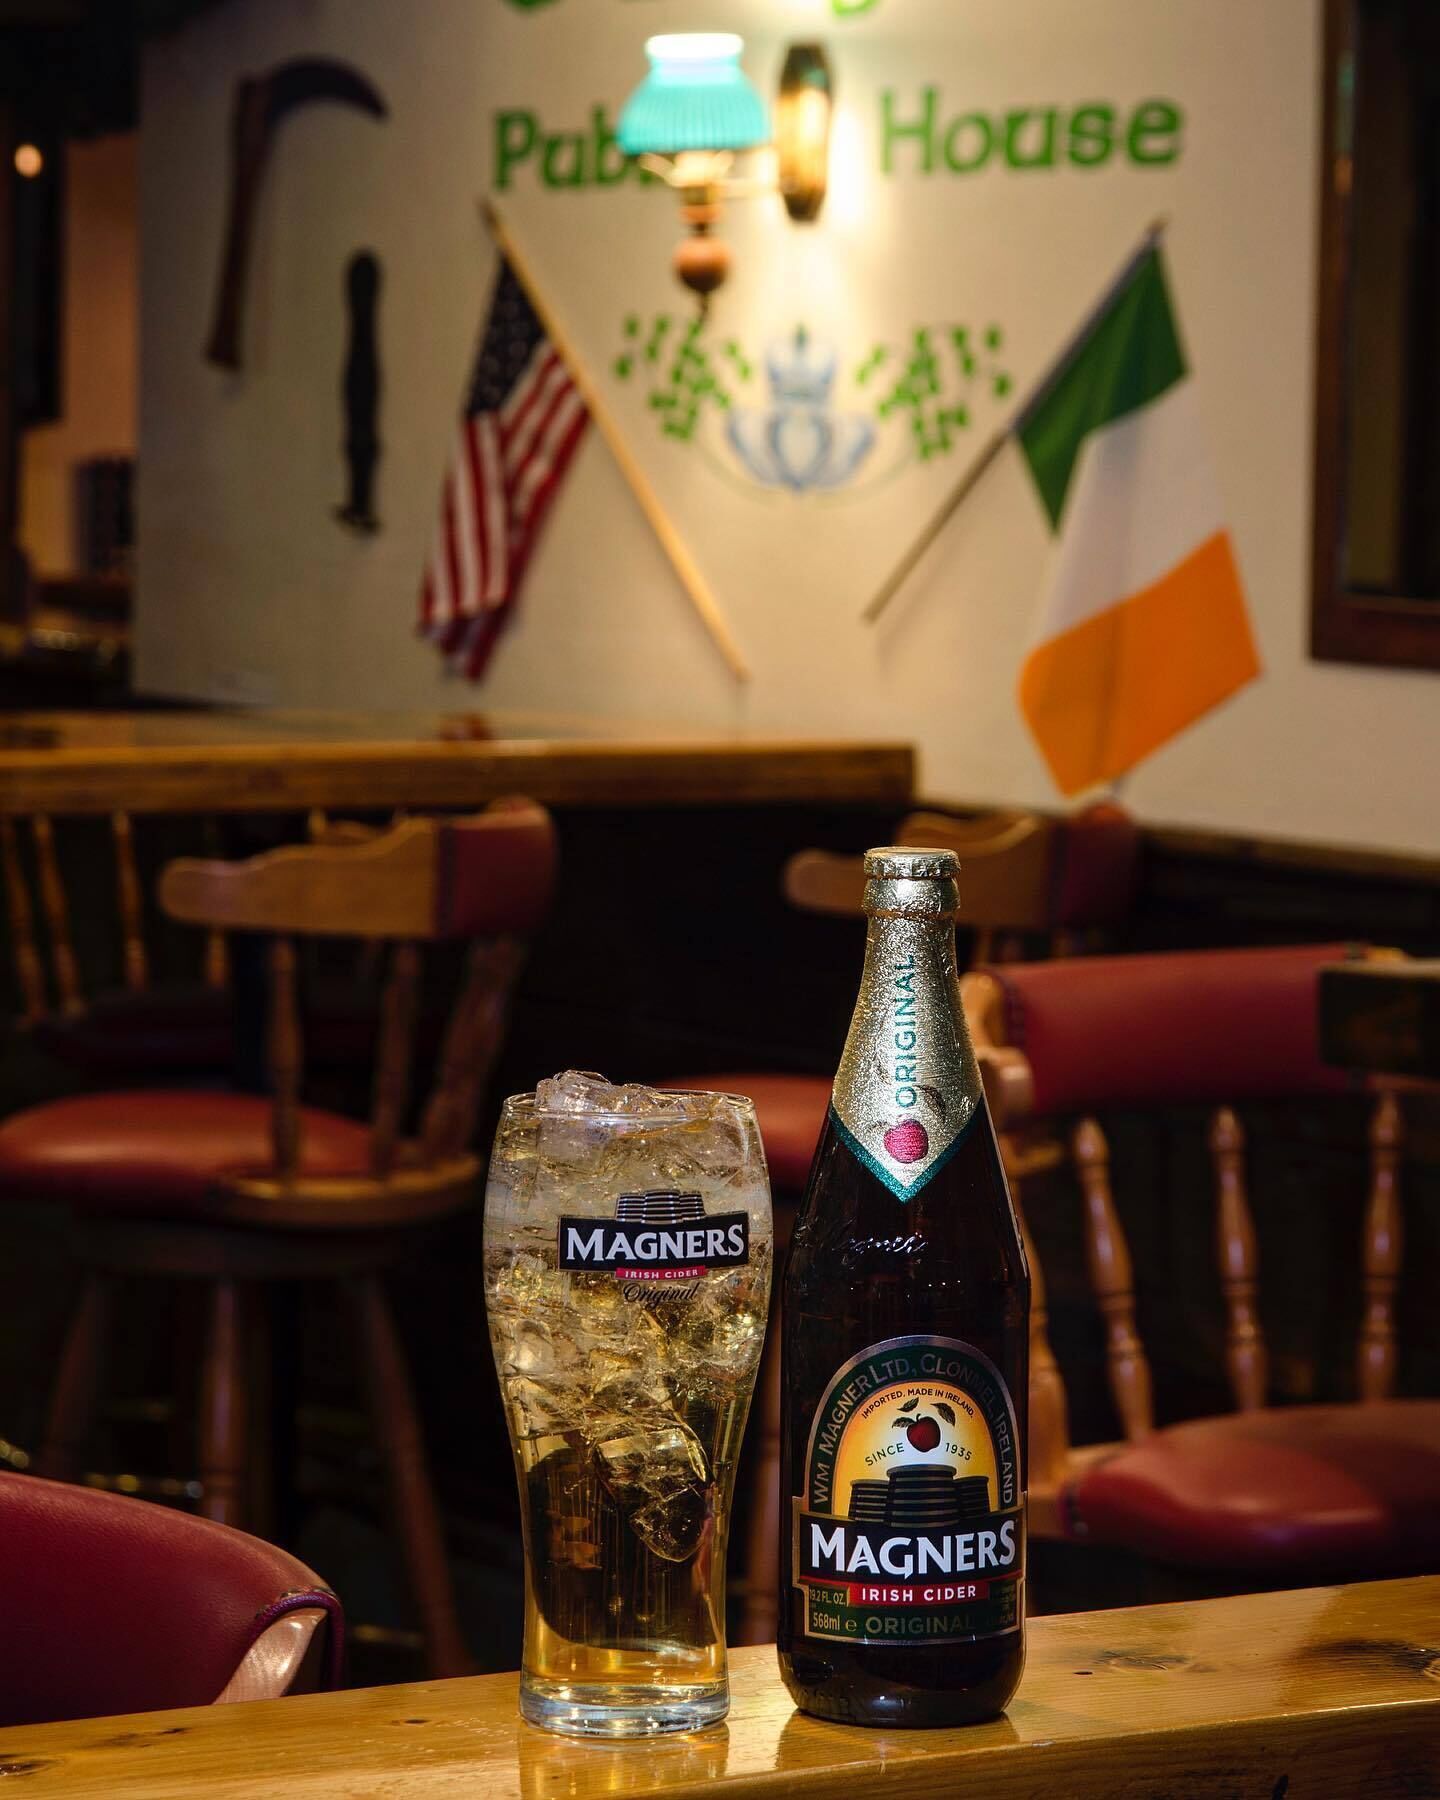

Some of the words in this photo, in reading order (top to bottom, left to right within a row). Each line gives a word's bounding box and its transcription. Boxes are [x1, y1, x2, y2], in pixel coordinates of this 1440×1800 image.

[880, 86, 1184, 178] House
[893, 953, 918, 1108] ORIGINAL
[566, 1223, 745, 1262] MAGNERS
[625, 1271, 659, 1279] IRISH
[664, 1268, 699, 1279] CIDER
[623, 1281, 701, 1311] Original
[907, 1388, 933, 1397] MADE
[935, 1388, 945, 1398] IN
[818, 1374, 872, 1457] MAGNER
[994, 1411, 1013, 1504] IRELAND
[865, 1442, 905, 1467] SINCE
[945, 1442, 972, 1461] 1935
[811, 1519, 1015, 1579] MAGNERS
[862, 1587, 913, 1602] IRISH
[923, 1585, 976, 1601] CIDER
[813, 1612, 840, 1631] 568ml
[865, 1615, 976, 1635] ORIGINAL
